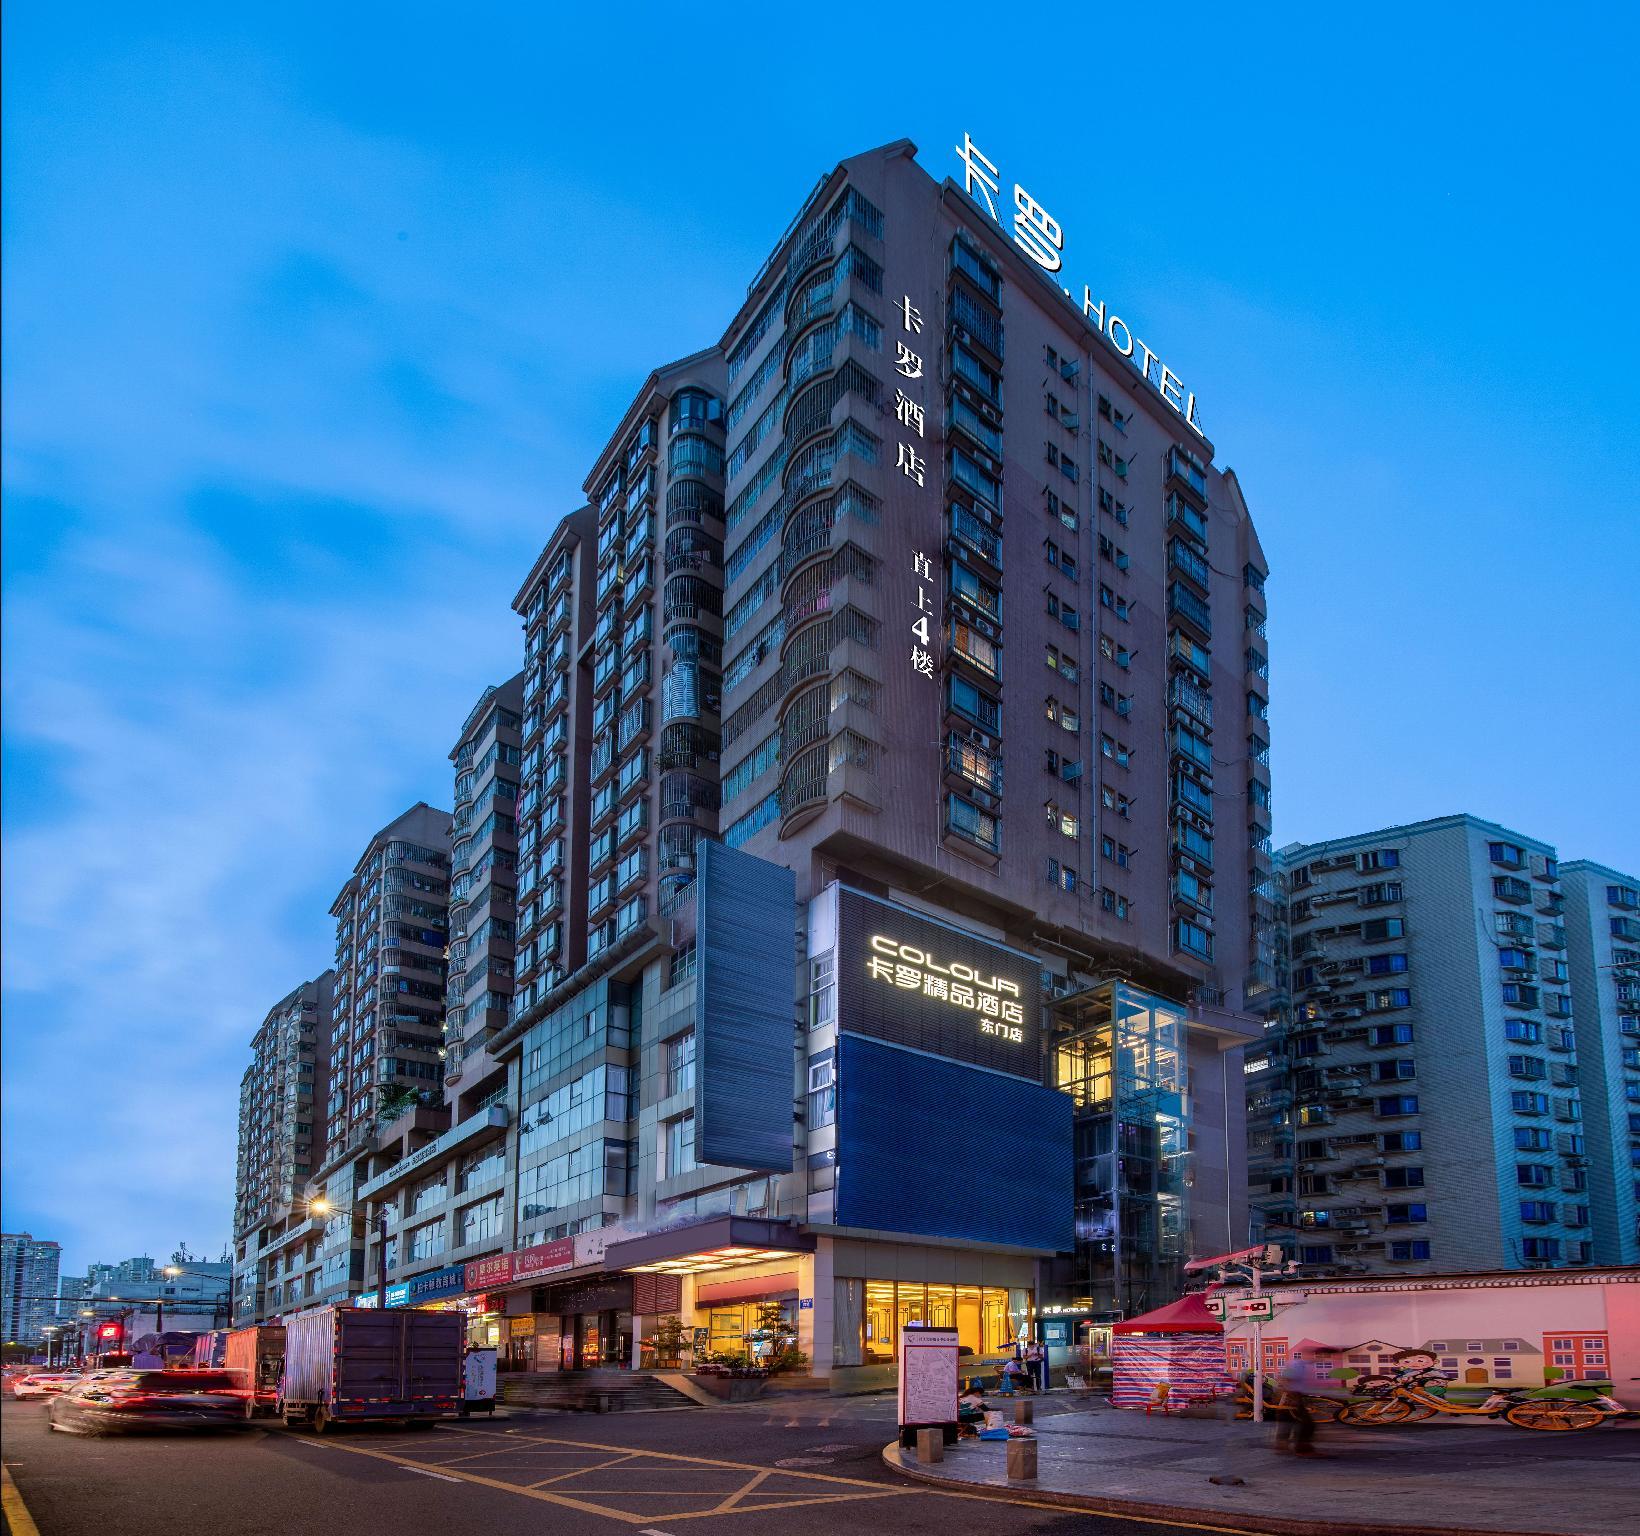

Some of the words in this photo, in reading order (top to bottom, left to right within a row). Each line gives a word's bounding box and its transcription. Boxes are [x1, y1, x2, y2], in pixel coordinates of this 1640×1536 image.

[955, 132, 1063, 271] 卡罗
[1084, 284, 1205, 437] HOTEL
[893, 295, 925, 488] 卡罗酒店
[910, 549, 934, 679] 直上4楼
[867, 956, 1023, 1024] 卡罗精品酒店
[871, 935, 1020, 998] COLOUR
[980, 1018, 1023, 1043] 东门店
